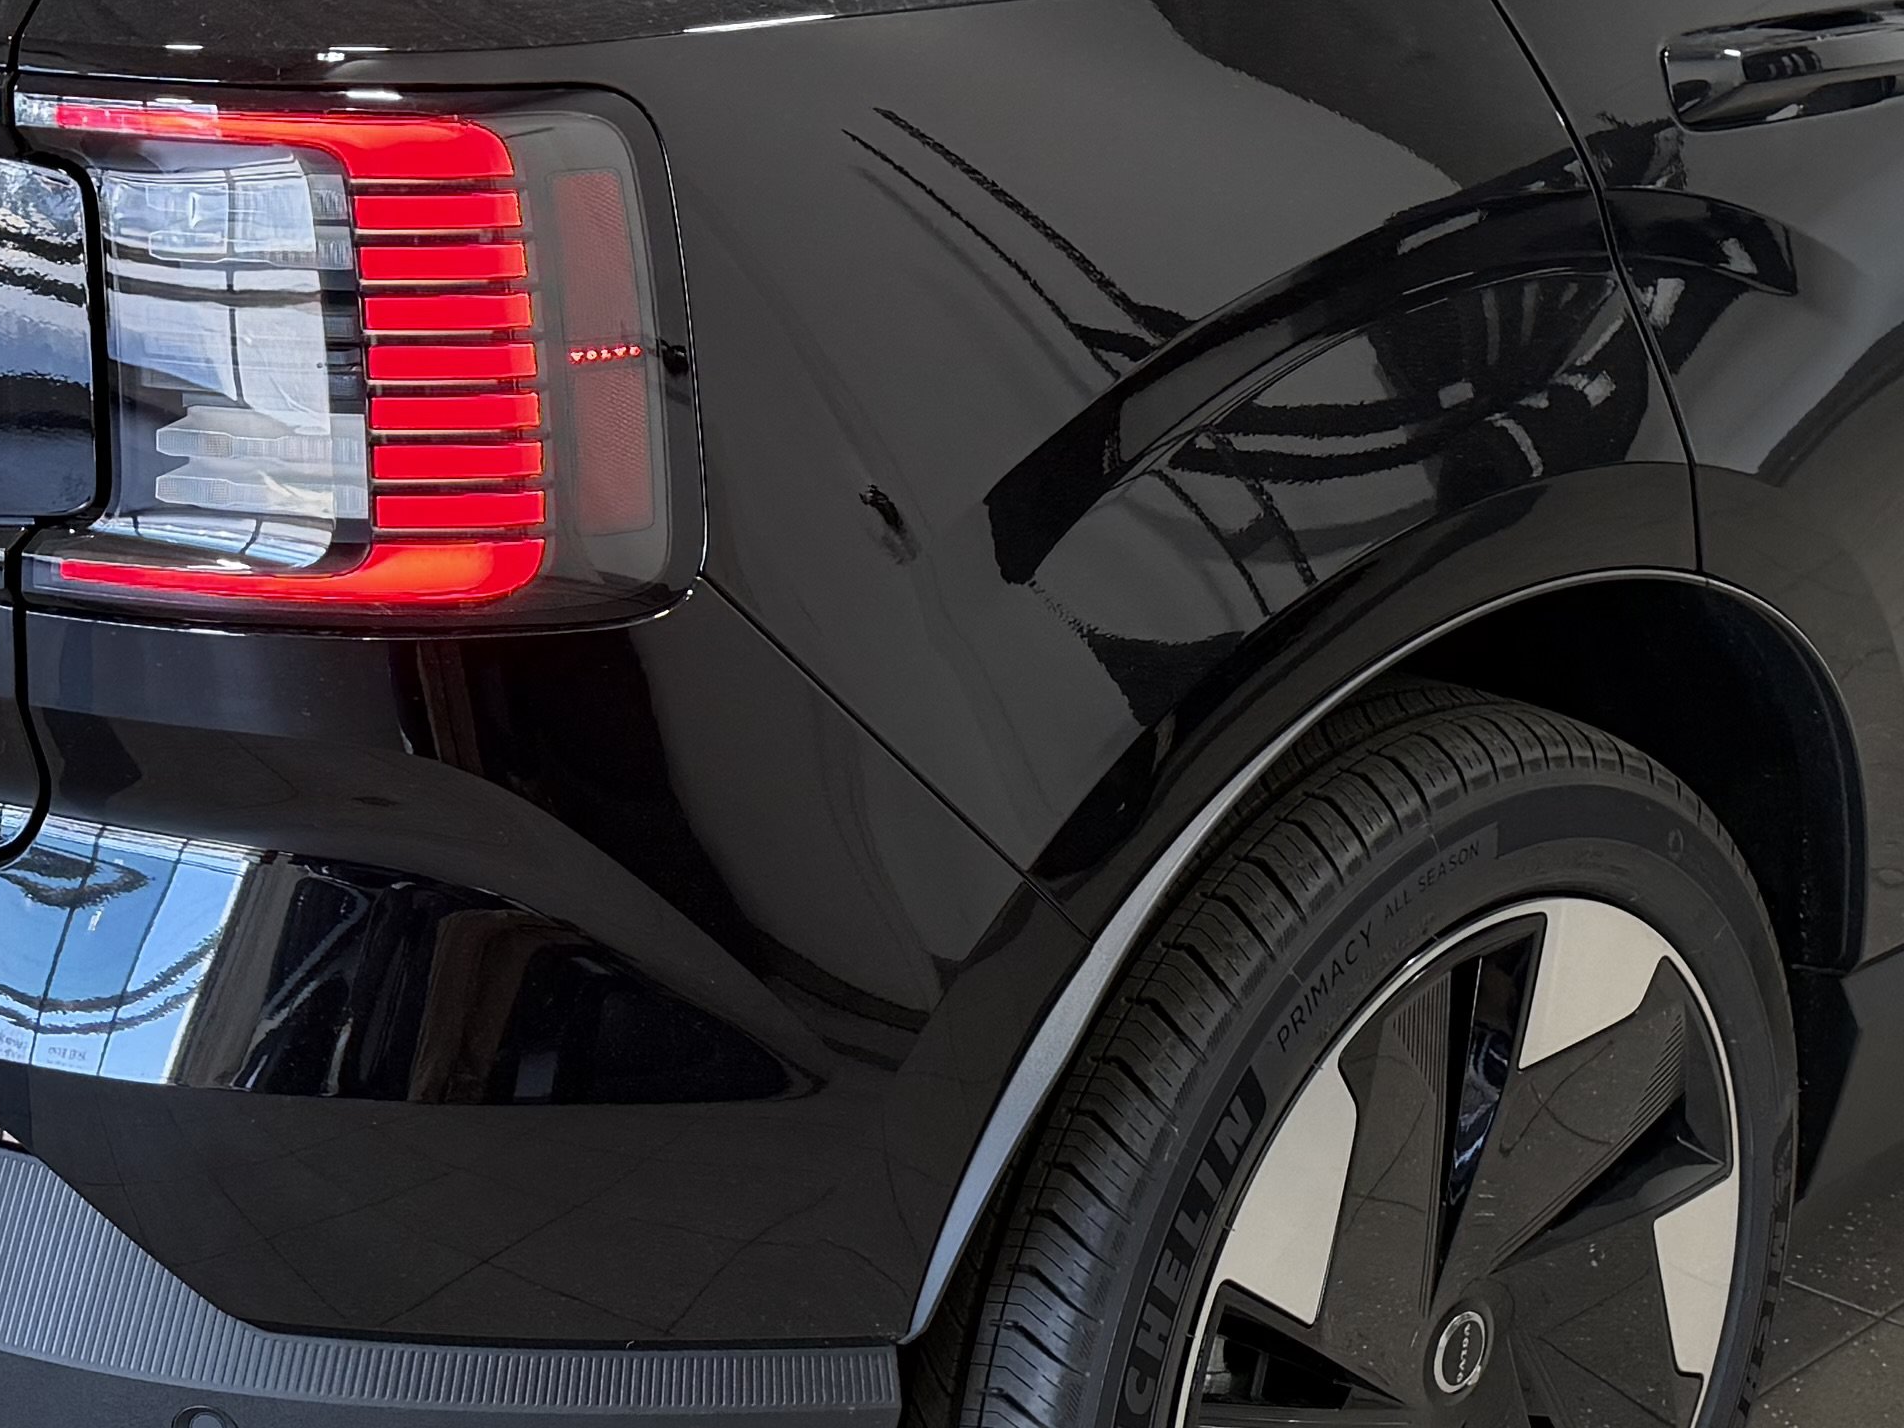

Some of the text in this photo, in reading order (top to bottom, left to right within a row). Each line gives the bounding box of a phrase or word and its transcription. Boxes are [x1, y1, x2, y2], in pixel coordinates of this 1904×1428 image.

[570, 346, 642, 362] VOLVO
[1276, 924, 1374, 1053] PRIMACY
[1383, 890, 1413, 921] ALL
[1418, 840, 1481, 892] SEASON
